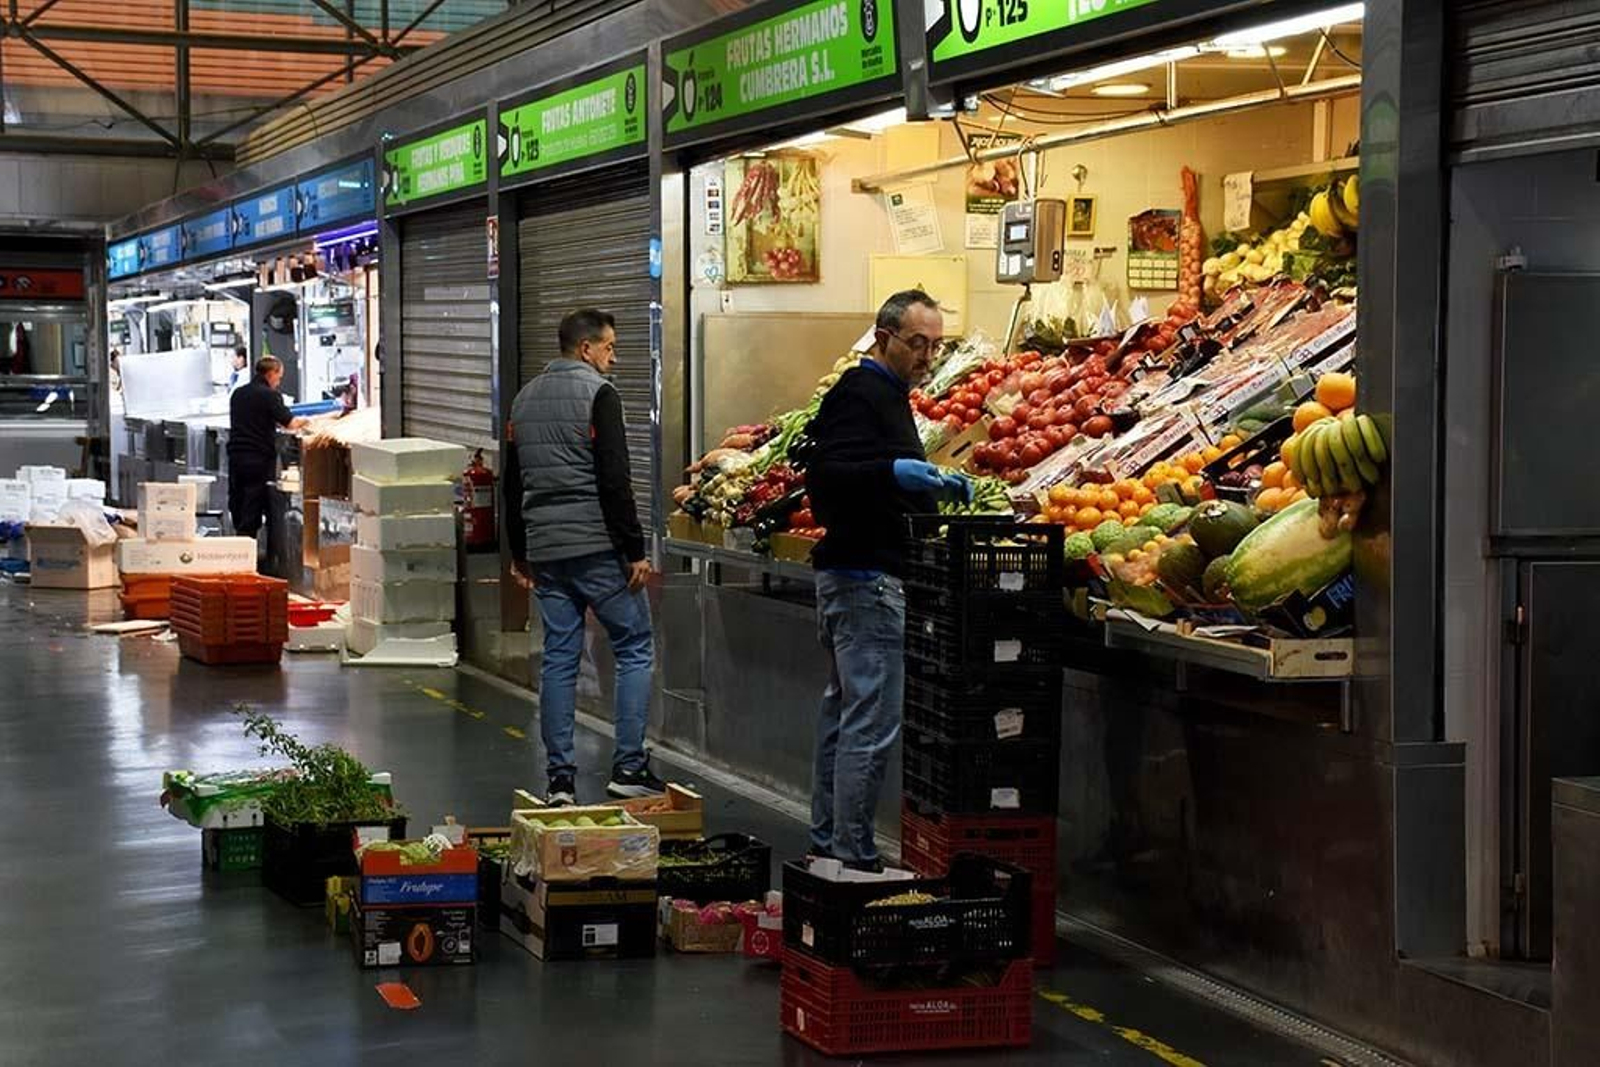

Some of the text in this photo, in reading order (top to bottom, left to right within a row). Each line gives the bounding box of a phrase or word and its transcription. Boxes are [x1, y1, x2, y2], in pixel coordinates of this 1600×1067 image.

[726, 2, 848, 71] FRUTAS HERMANOS
[739, 56, 809, 103] CUMBRERA
[541, 103, 571, 135] FRUTAS
